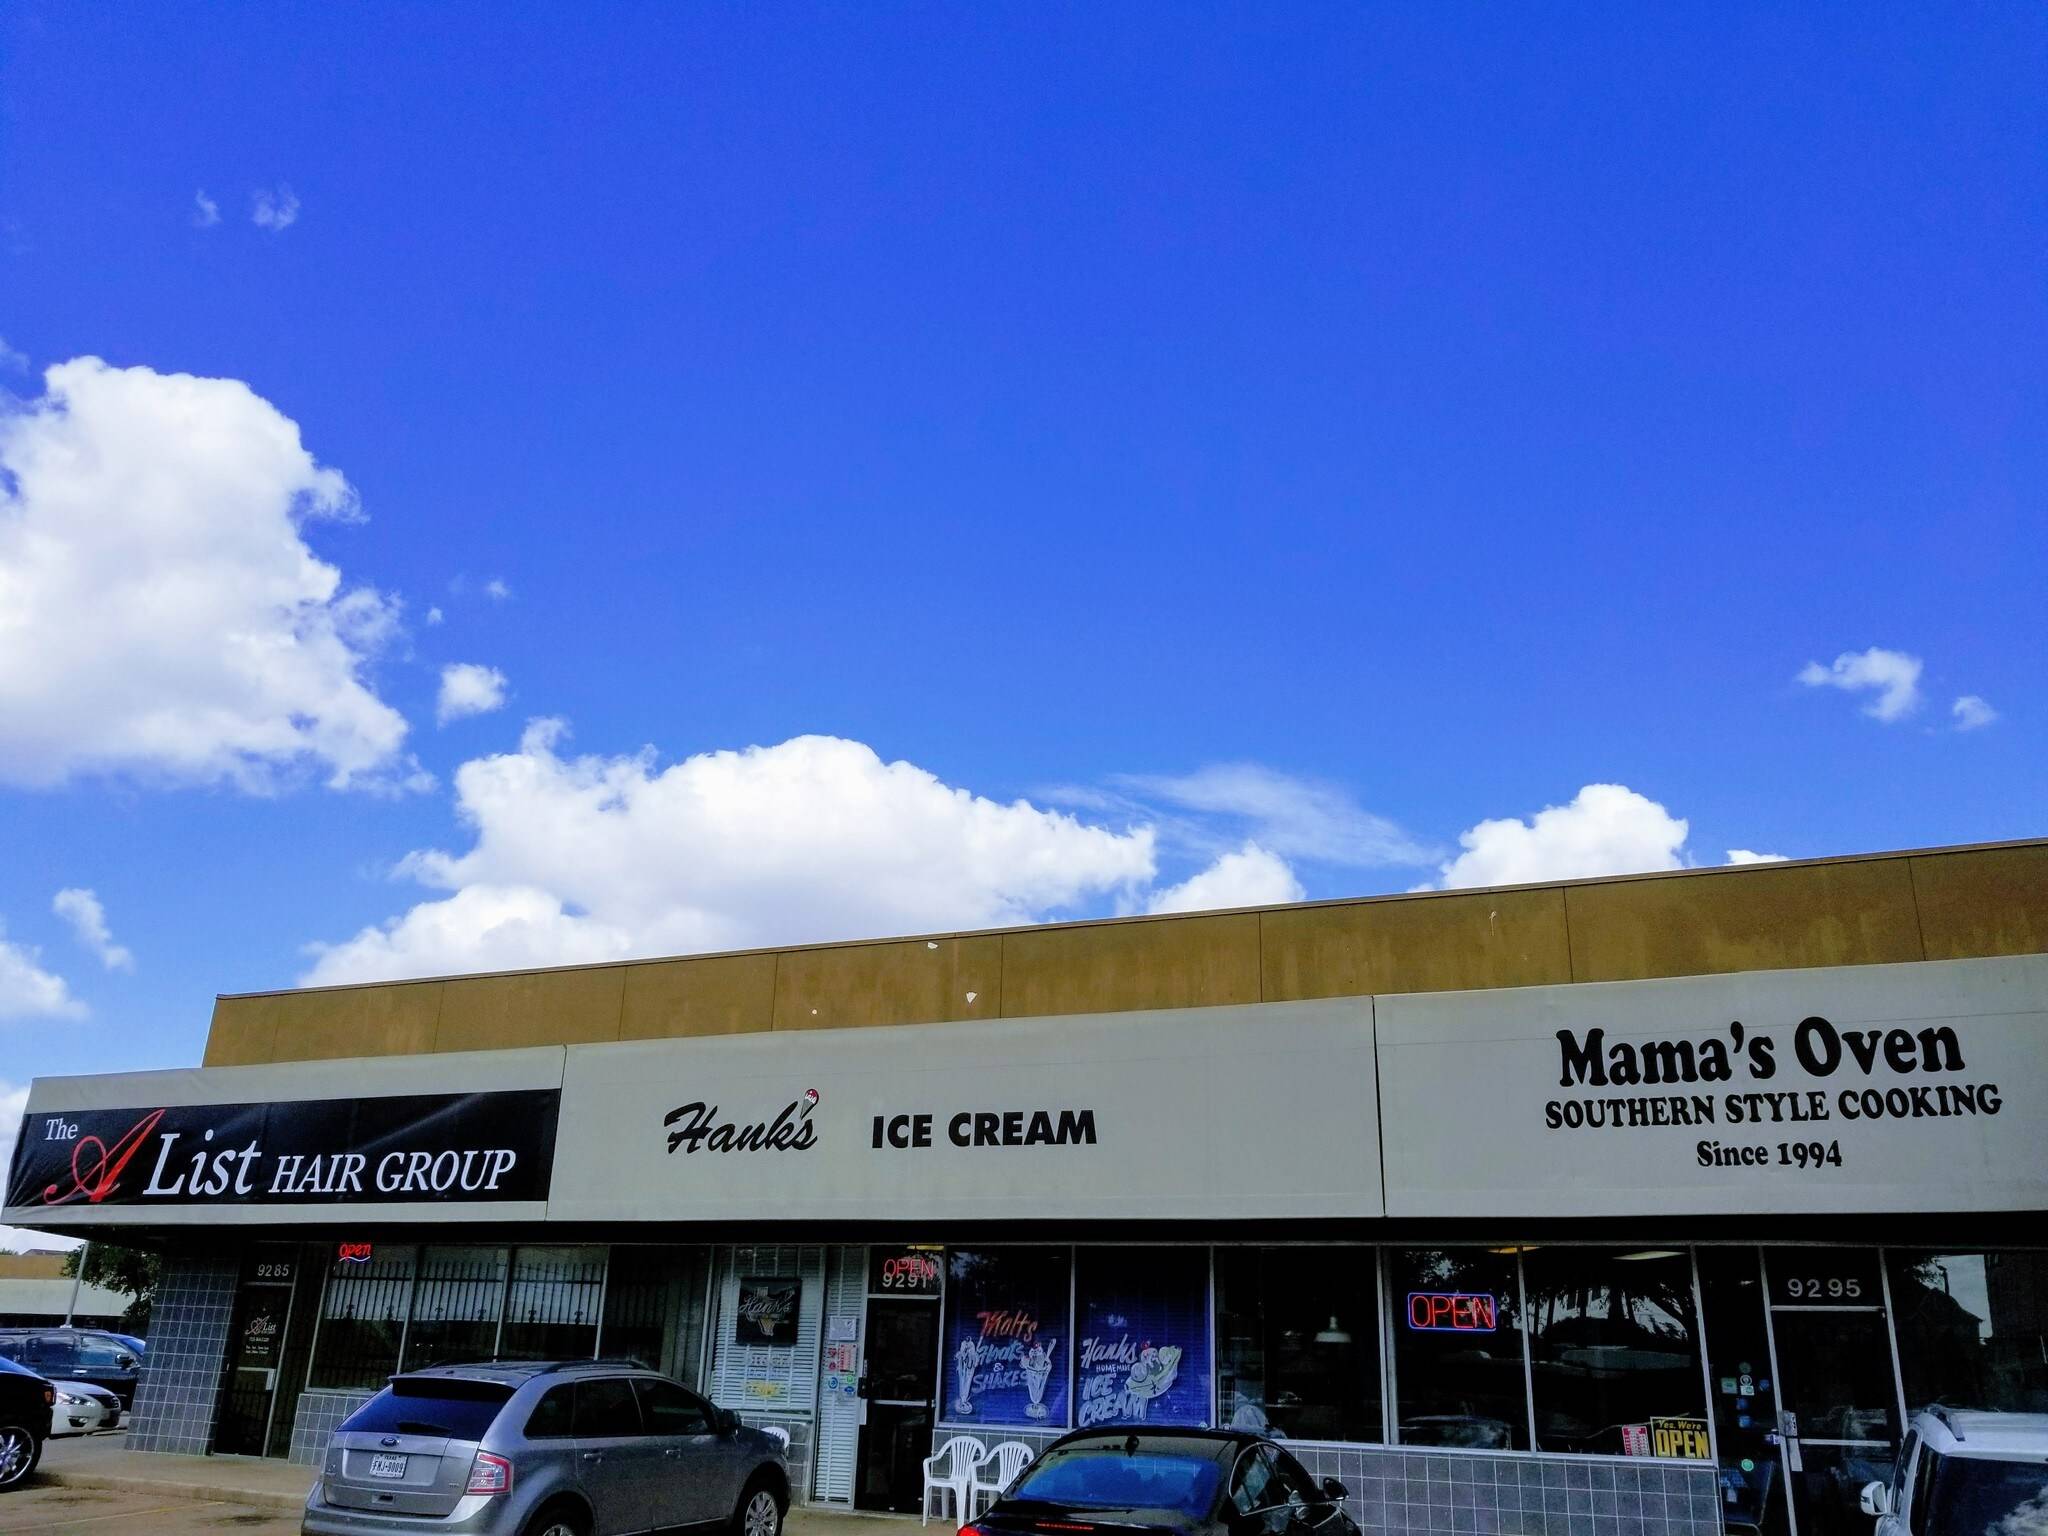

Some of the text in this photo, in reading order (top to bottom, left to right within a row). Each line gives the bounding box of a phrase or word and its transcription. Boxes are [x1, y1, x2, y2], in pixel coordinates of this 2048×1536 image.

[1556, 1016, 1966, 1087] Mama's Oven
[663, 1088, 820, 1154] Hank's
[1545, 1083, 2003, 1129] SOUTHERN STYLE COOKING
[45, 1117, 78, 1141] The
[871, 1109, 1098, 1149] ICE CREAM
[42, 1108, 517, 1204] A List HAIR GROUP
[1696, 1140, 1843, 1169] Since 1994
[257, 1264, 290, 1277] 9285
[882, 1272, 928, 1289] 9291
[884, 1258, 935, 1281] OPEN
[1787, 1278, 1862, 1298] 9295
[1411, 1294, 1495, 1328] OPEN
[1655, 1429, 1712, 1459] OPEN
